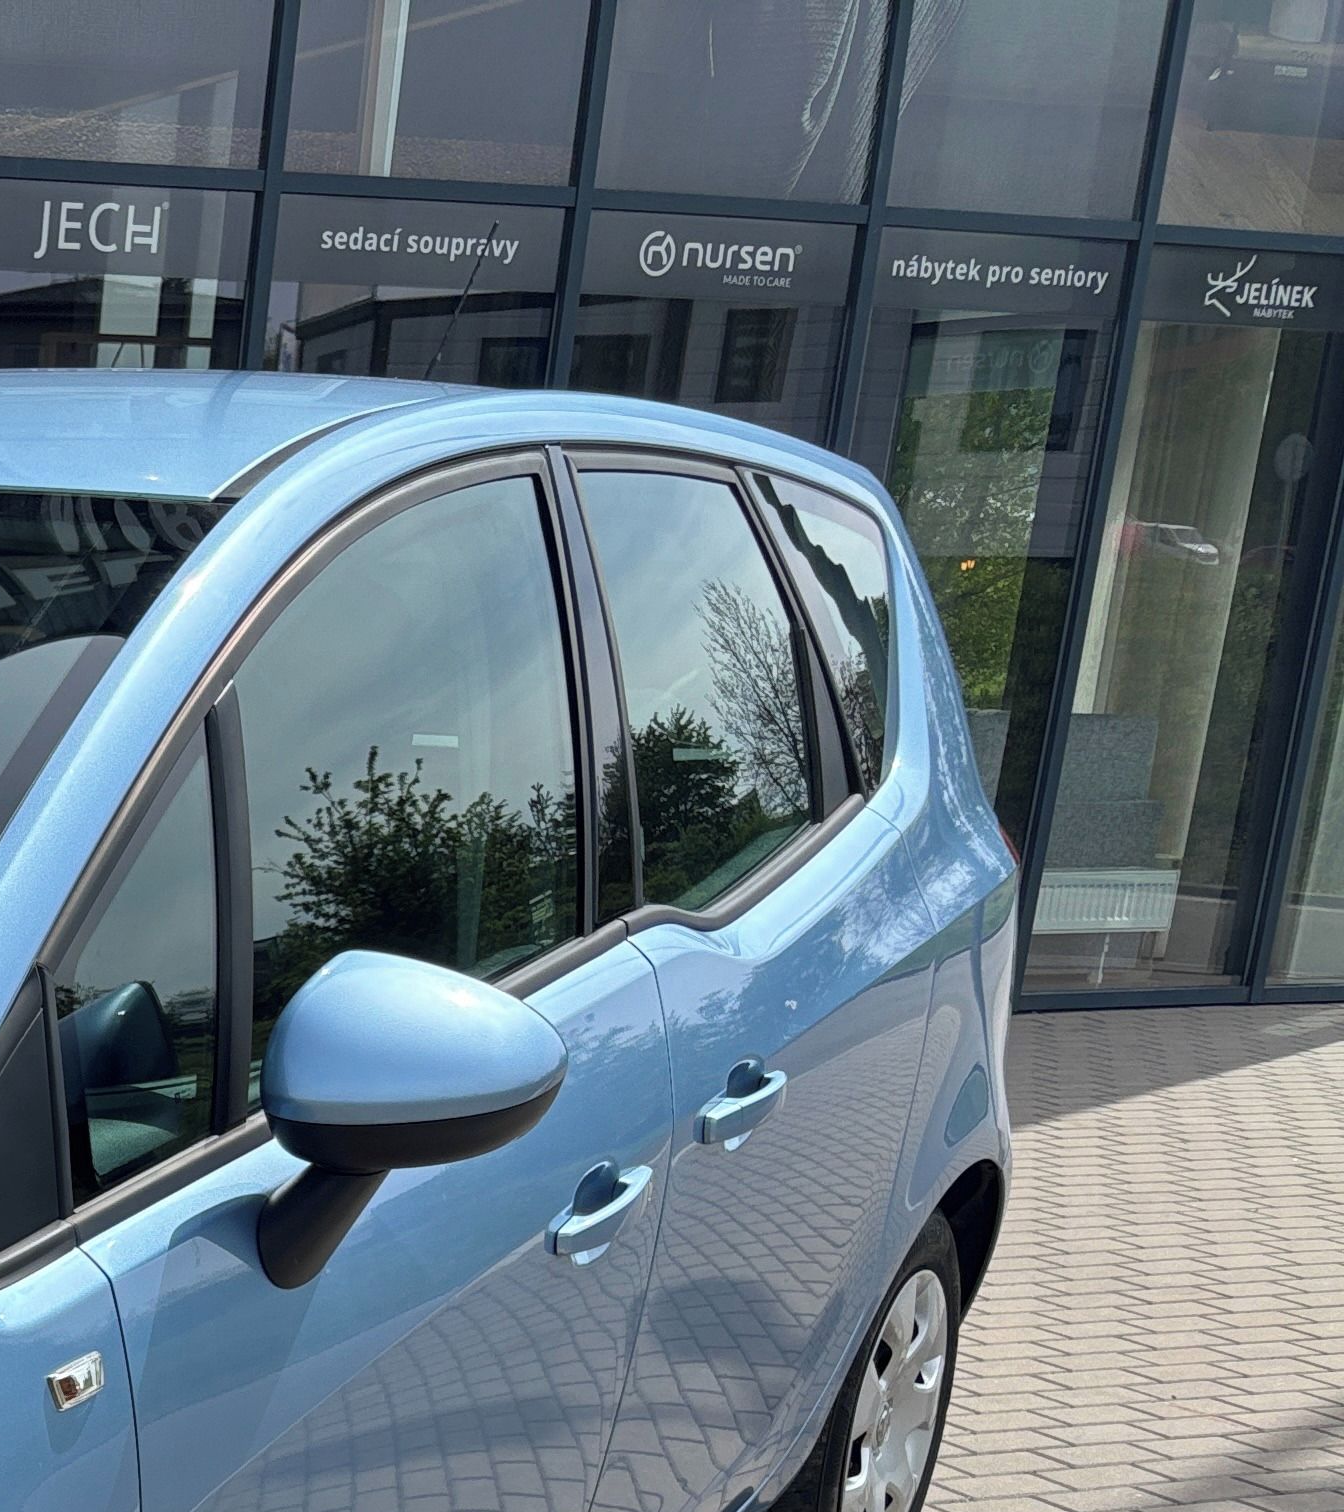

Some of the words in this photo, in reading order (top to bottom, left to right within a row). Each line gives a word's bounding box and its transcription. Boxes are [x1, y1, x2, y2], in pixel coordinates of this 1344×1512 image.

[320, 226, 402, 252] sedací
[407, 234, 519, 265] soupravy
[723, 274, 750, 286] MADE
[753, 276, 765, 287] TO
[766, 277, 792, 288] CARE
[892, 255, 981, 285] nábytek
[986, 265, 1024, 288] pro
[1029, 264, 1109, 294] seniory
[1235, 277, 1318, 308] JELÍNEK
[1252, 307, 1294, 320] NÁBYTEK
